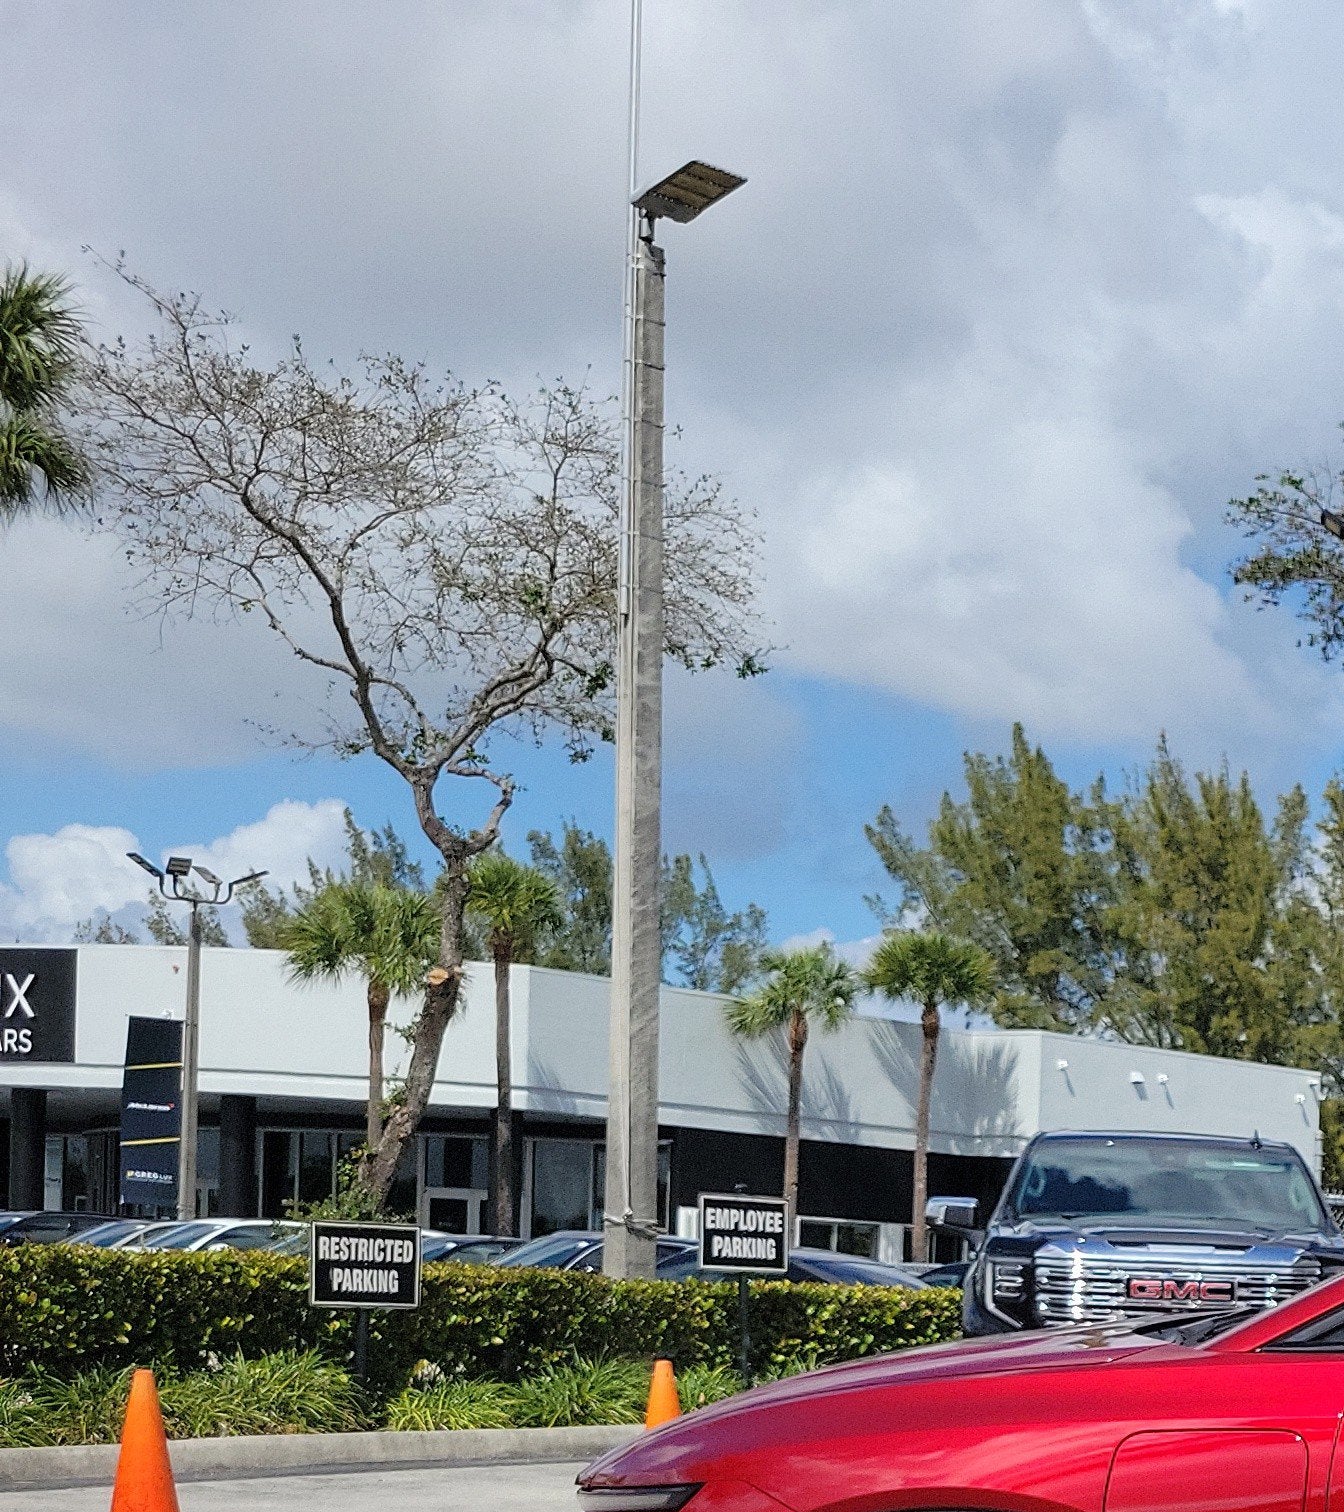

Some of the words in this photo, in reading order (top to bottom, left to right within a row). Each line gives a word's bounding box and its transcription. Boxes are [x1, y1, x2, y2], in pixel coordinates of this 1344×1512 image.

[0, 973, 35, 1018] X
[0, 1028, 33, 1053] RS
[705, 1206, 783, 1233] EMPLOYEE
[318, 1236, 413, 1264] RESTRICTED
[711, 1235, 776, 1260] PARKING
[330, 1267, 399, 1294] PARKING
[1129, 1279, 1232, 1301] GMC
